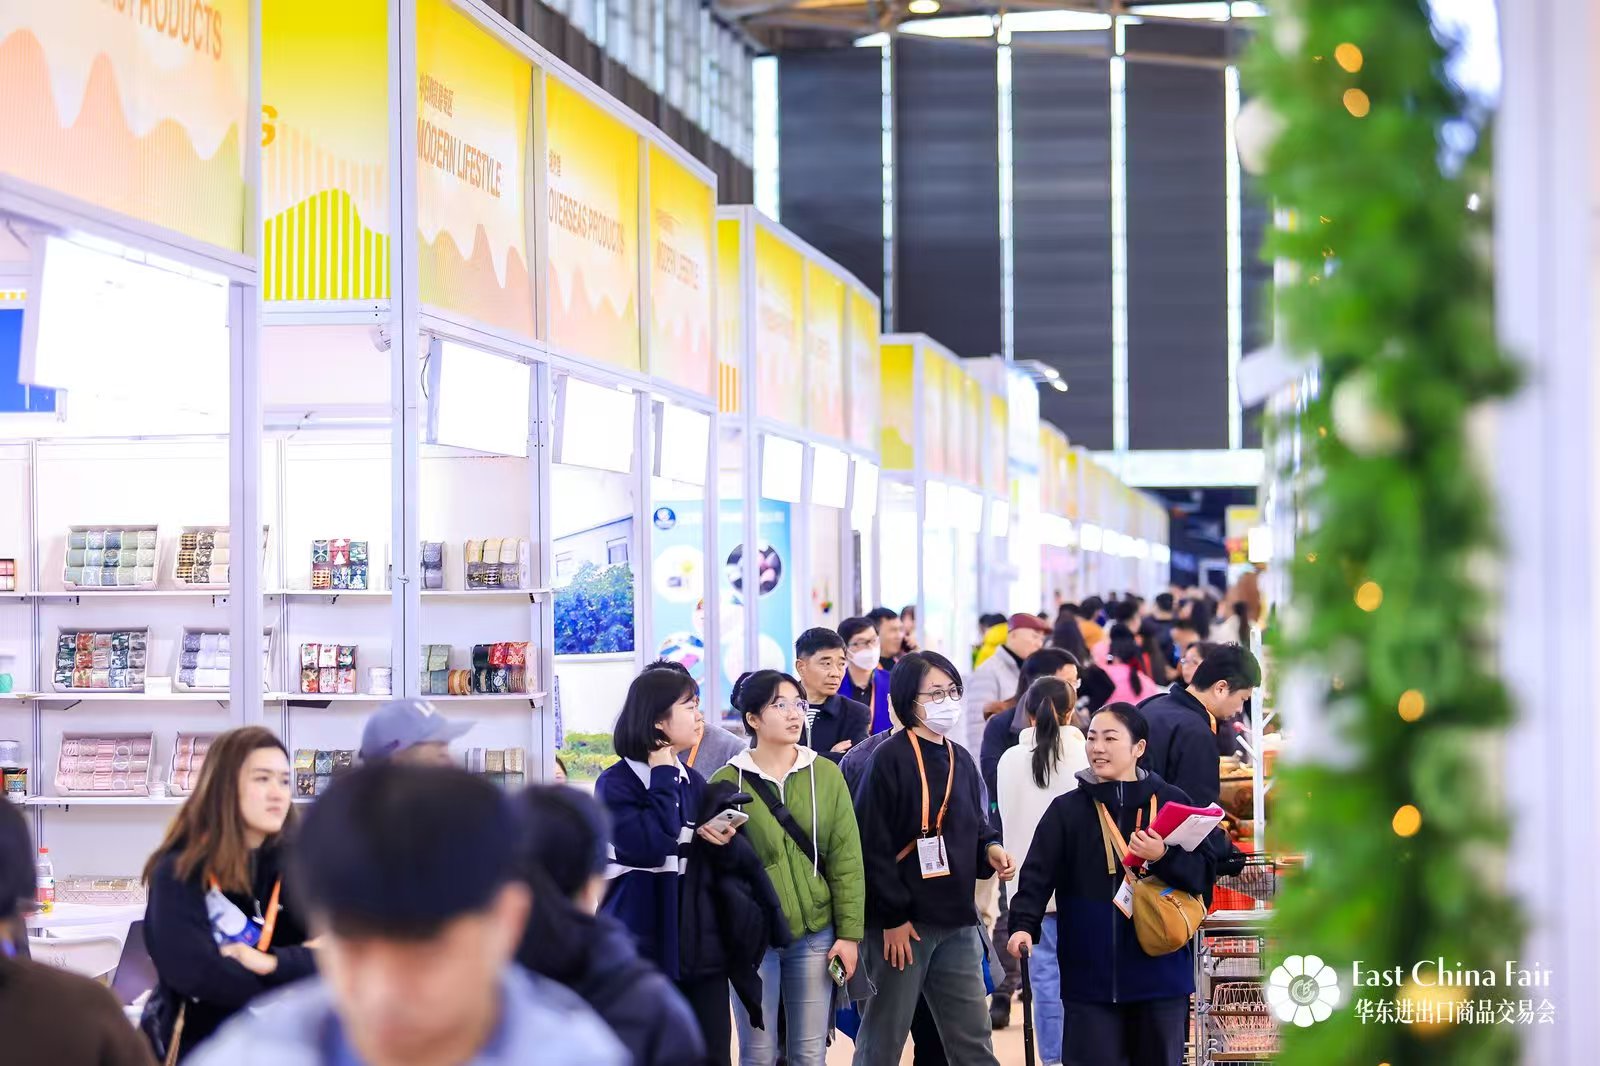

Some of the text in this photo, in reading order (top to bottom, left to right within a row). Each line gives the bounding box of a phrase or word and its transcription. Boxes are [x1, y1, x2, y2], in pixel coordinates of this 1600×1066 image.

[417, 117, 455, 175] MODERN
[457, 139, 502, 198] LIFESTYLE
[548, 187, 587, 239] OVERSEAS
[587, 207, 625, 256] PRODUCTS
